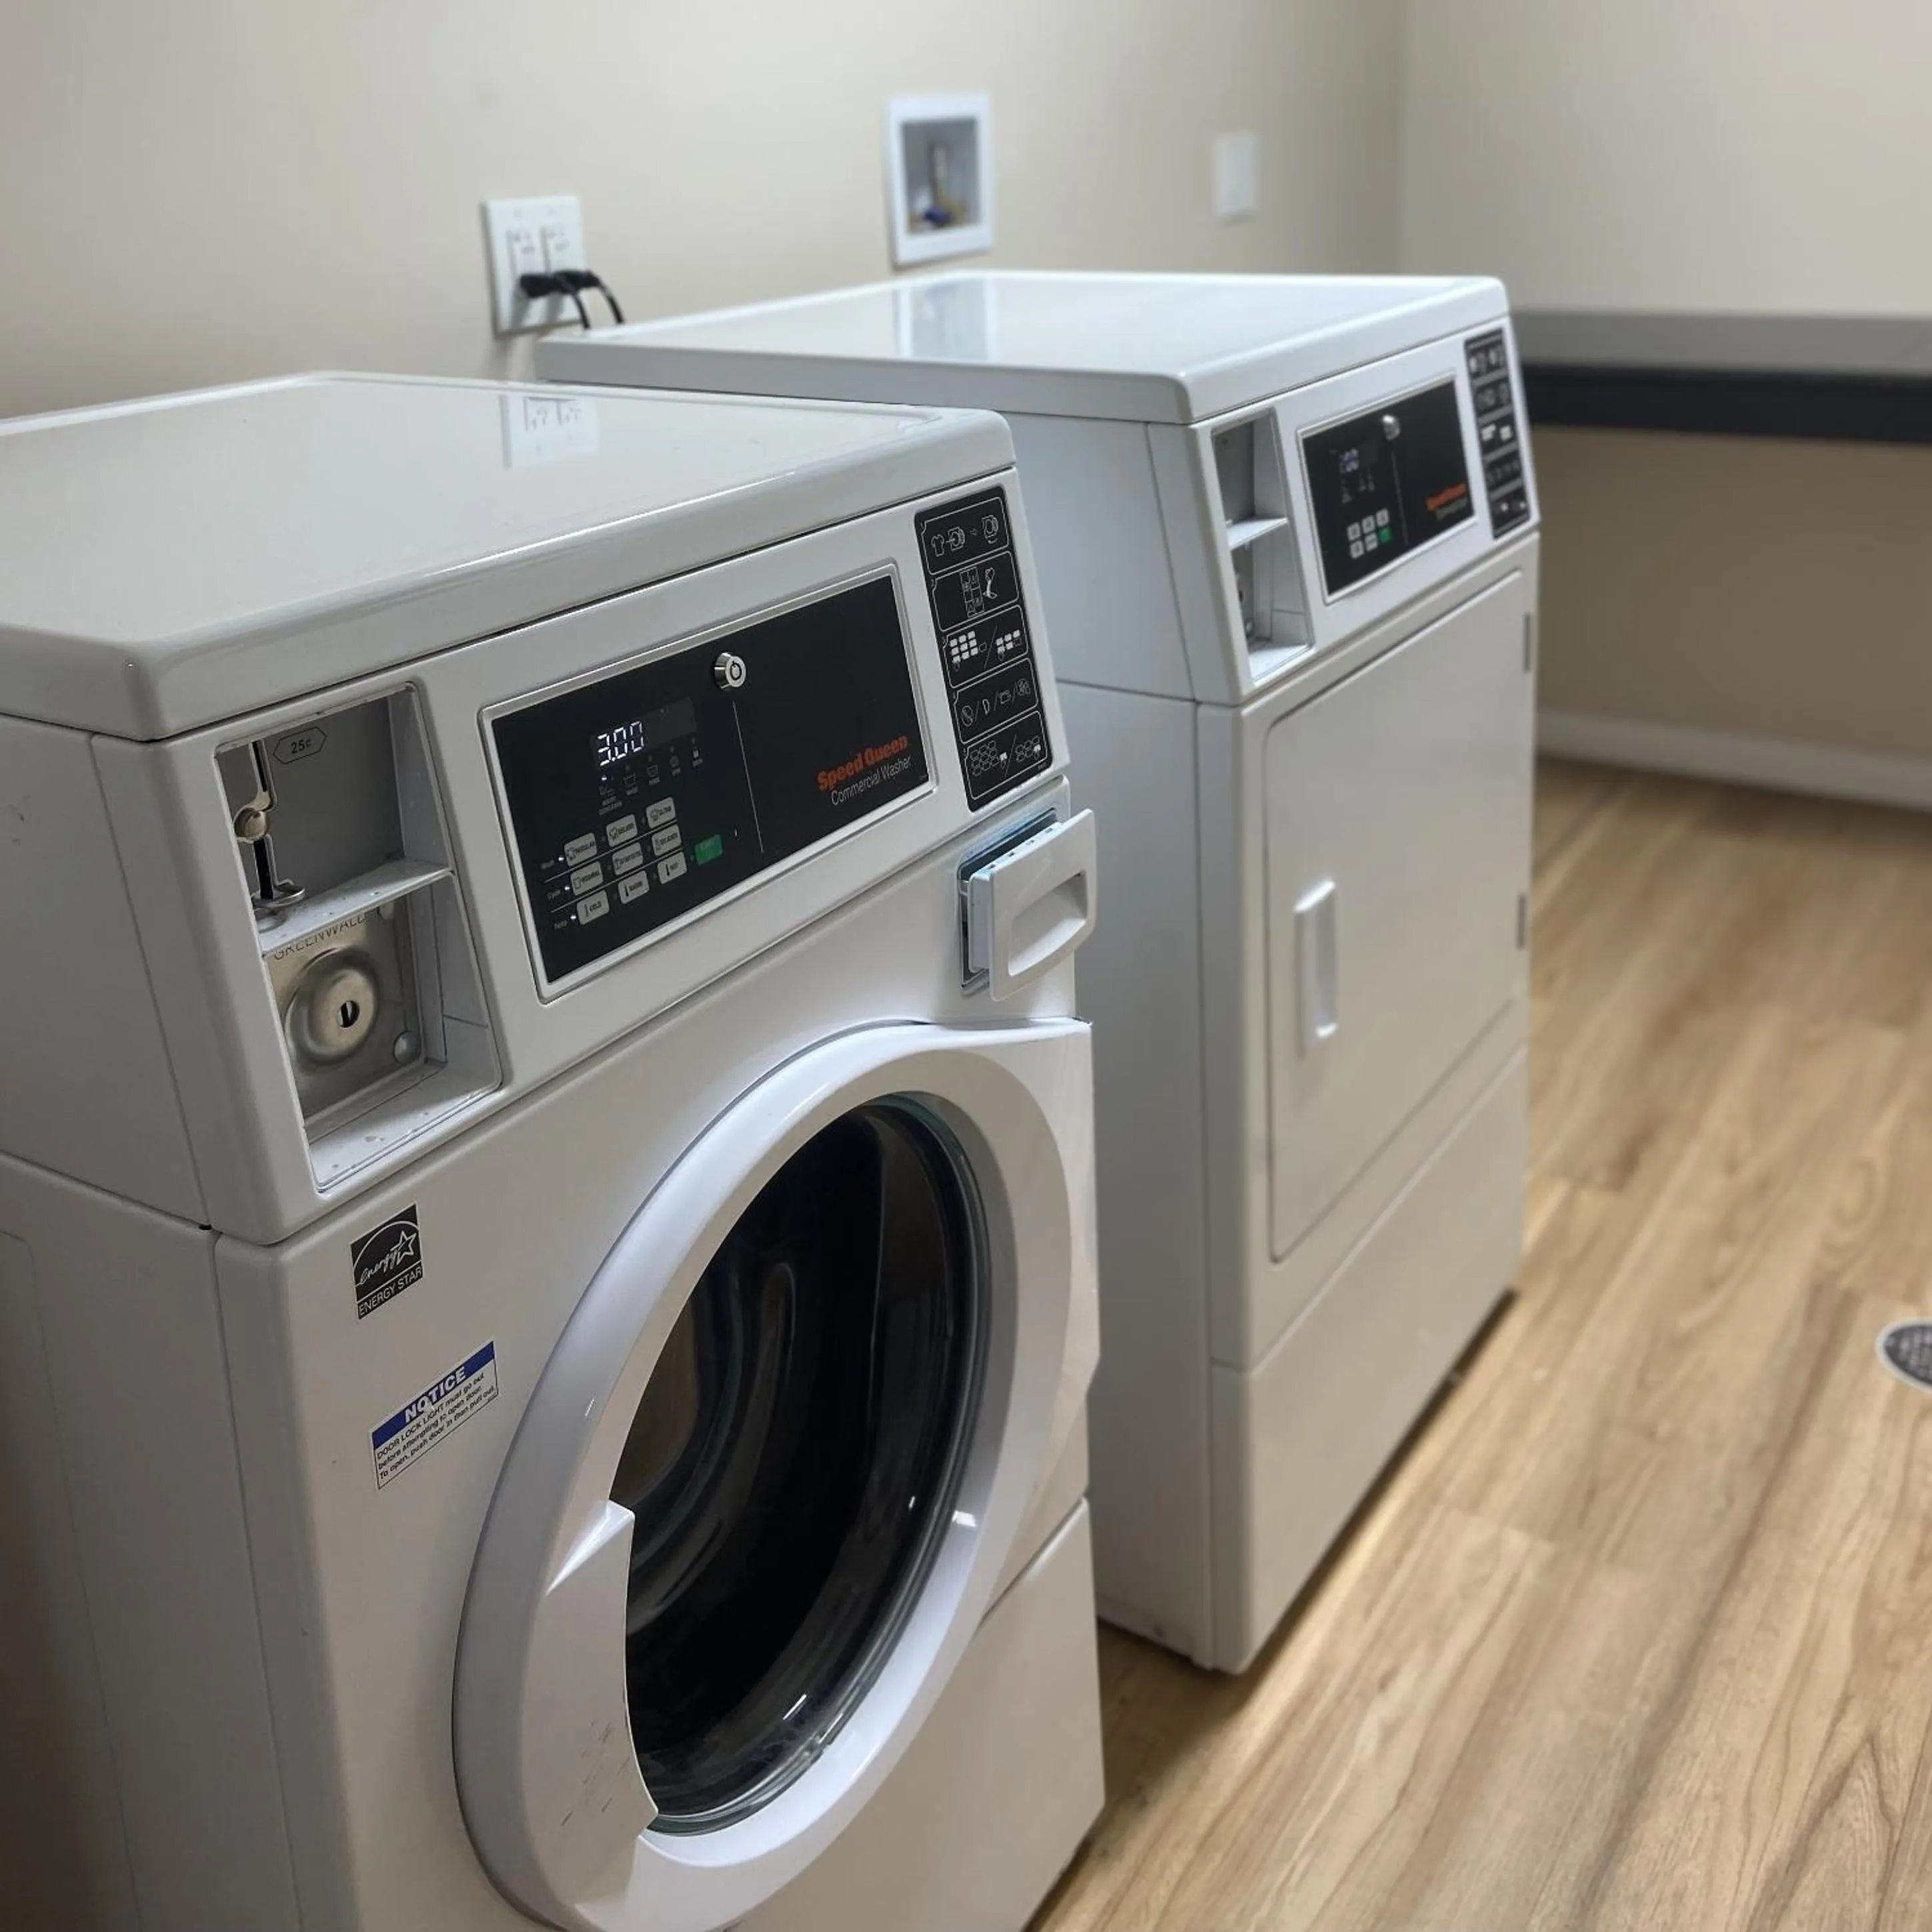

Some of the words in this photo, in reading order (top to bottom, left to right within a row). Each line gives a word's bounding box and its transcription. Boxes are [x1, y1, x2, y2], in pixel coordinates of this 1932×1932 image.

[598, 721, 644, 766] 3.00
[817, 752, 864, 790] Speed
[864, 735, 907, 766] Queen
[831, 770, 880, 805] Commercial
[880, 755, 911, 780] Washer
[358, 1283, 396, 1316] ENERGY
[397, 1266, 422, 1290] STAR
[377, 1438, 399, 1459] DOOR
[401, 1420, 421, 1441] LOCK
[423, 1404, 443, 1425] LIGHT
[445, 1390, 463, 1408] must
[465, 1383, 471, 1394] go
[473, 1372, 484, 1385] out
[404, 1366, 467, 1422] NOTICE
[379, 1448, 401, 1470] before
[403, 1419, 438, 1453] attempting
[448, 1400, 464, 1416] open
[379, 1469, 388, 1479] To
[411, 1439, 428, 1457] push
[429, 1424, 444, 1441] door
[446, 1418, 453, 1427] in
[454, 1407, 469, 1422] then
[470, 1392, 482, 1410] pull
